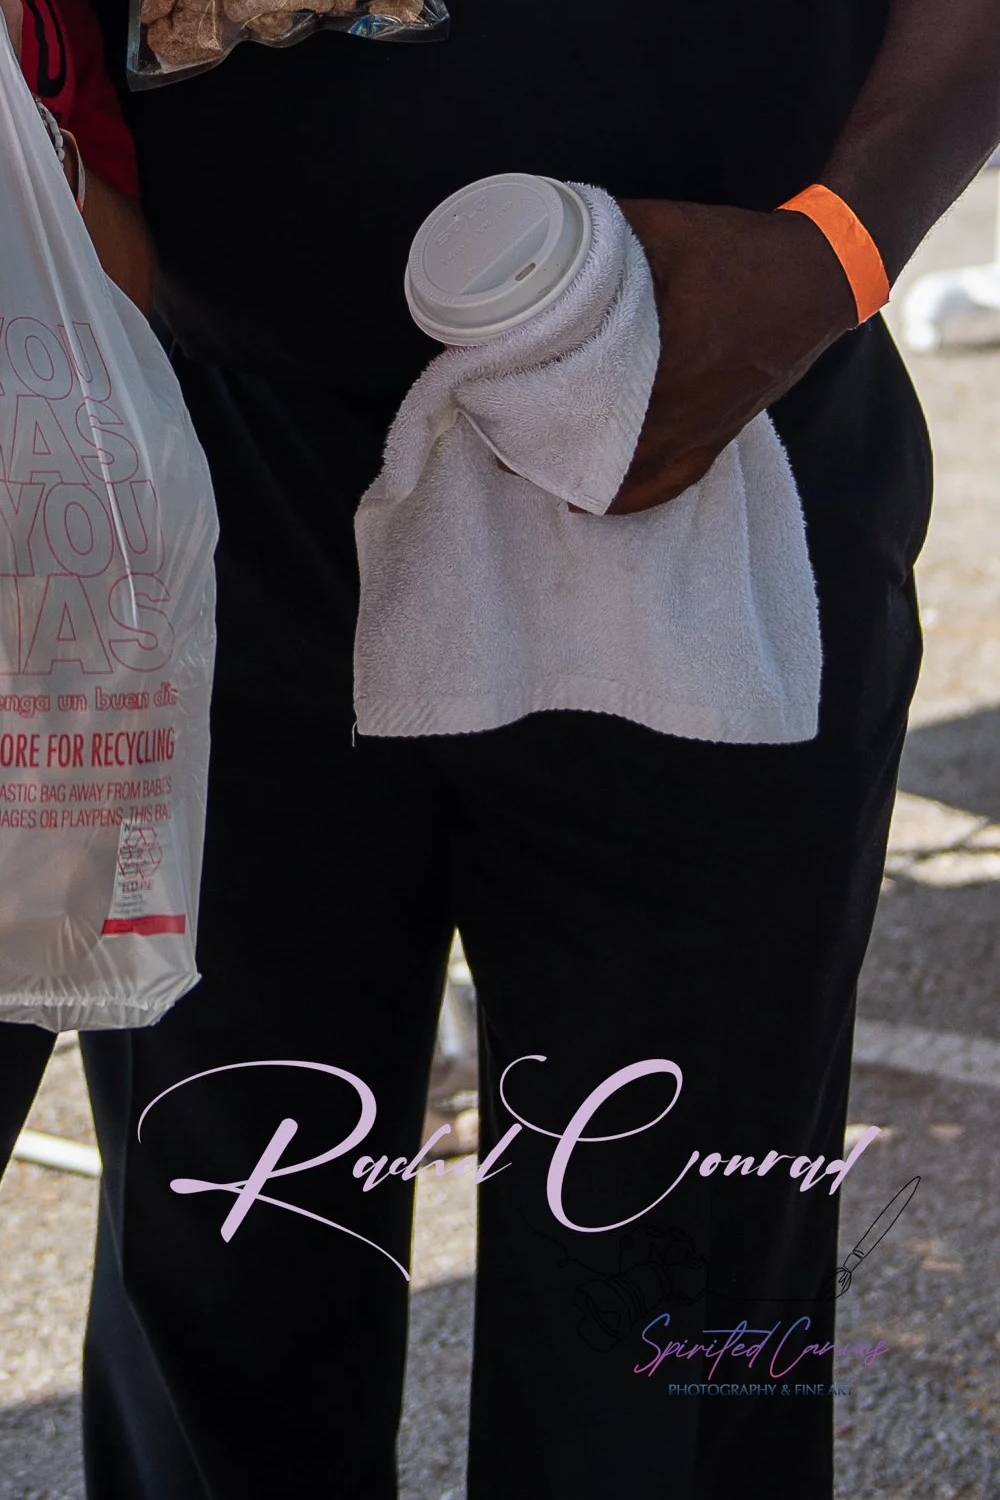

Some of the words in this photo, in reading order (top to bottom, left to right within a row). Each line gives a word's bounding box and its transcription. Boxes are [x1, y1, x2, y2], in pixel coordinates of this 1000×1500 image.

[57, 693, 88, 712] un
[95, 686, 149, 711] buen
[46, 731, 84, 768] FOR
[90, 726, 175, 767] RECYCLING
[40, 784, 67, 802] BAG
[68, 782, 104, 801] AWAY
[106, 781, 141, 801] FROM
[40, 810, 58, 828] OR
[129, 804, 153, 824] THIS
